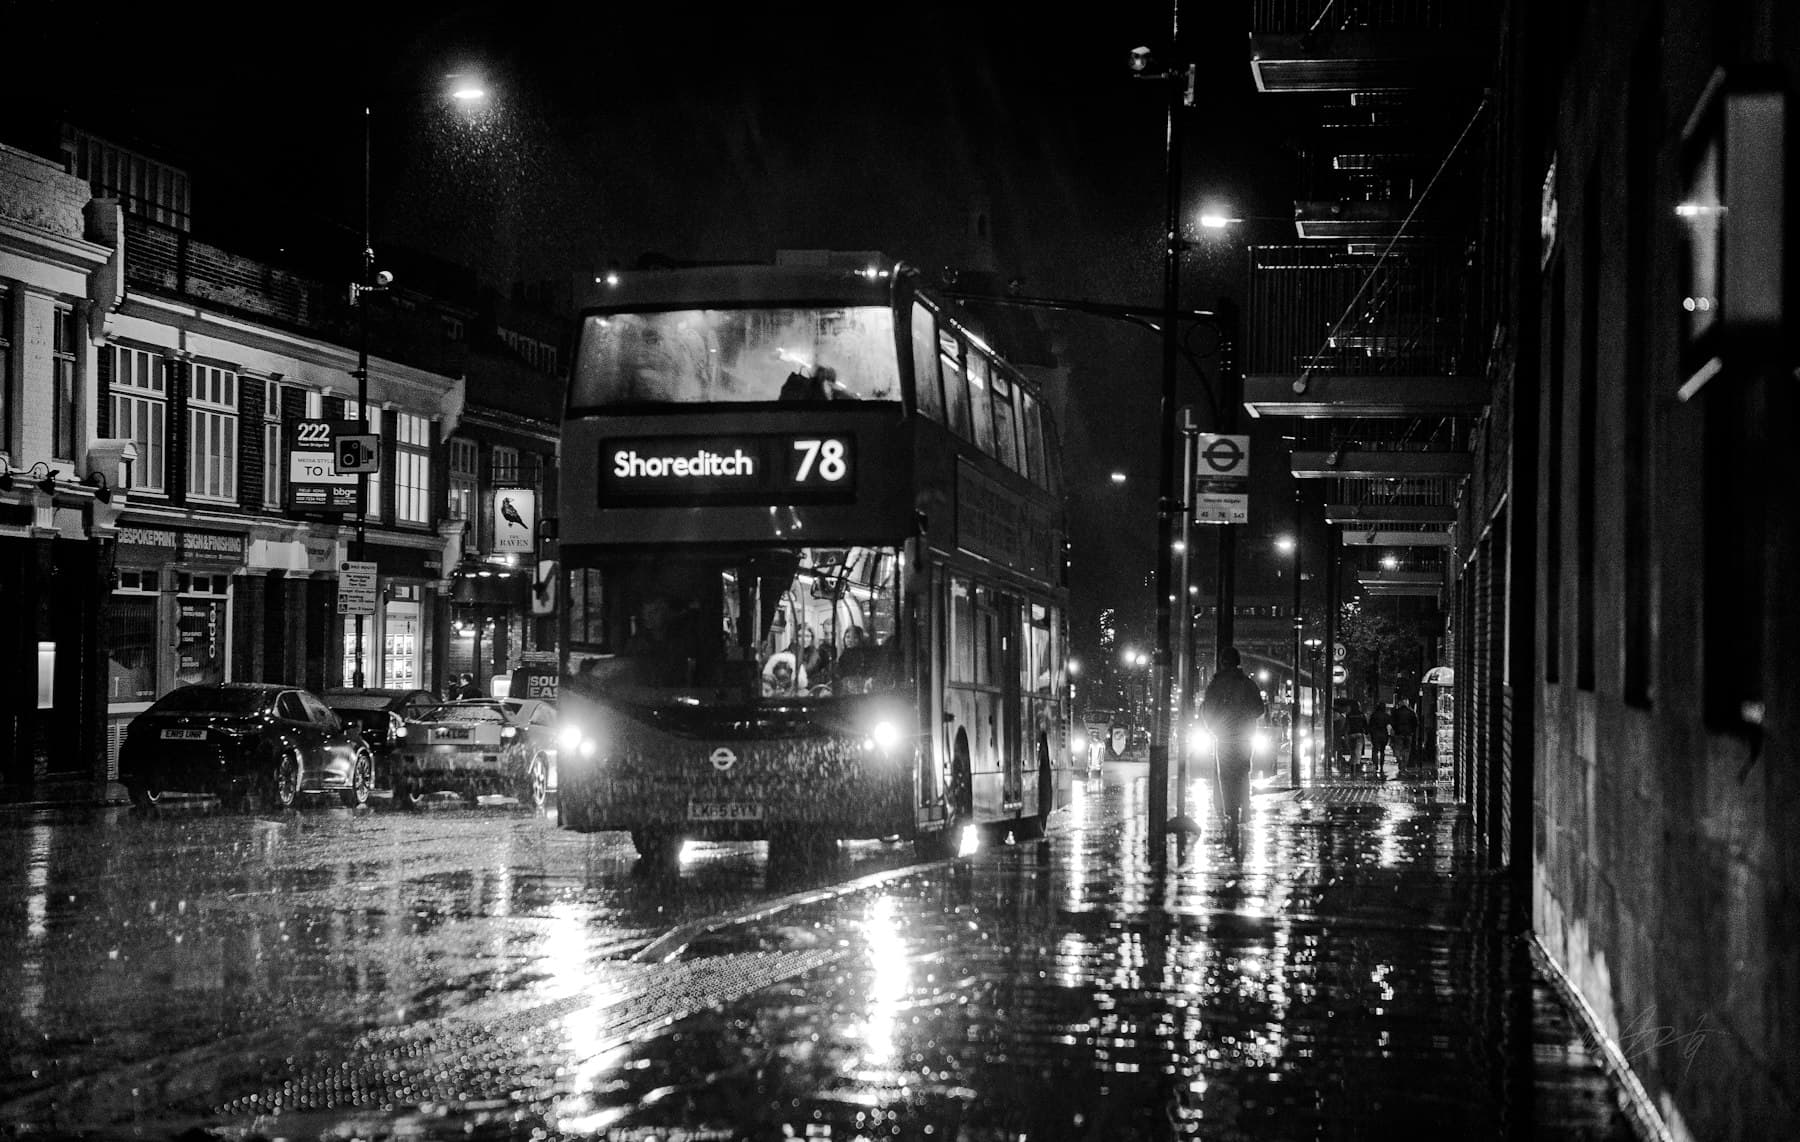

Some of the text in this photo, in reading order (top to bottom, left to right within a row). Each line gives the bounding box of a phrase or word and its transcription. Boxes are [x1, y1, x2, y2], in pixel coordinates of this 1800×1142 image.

[298, 423, 330, 442] 222
[614, 439, 846, 482] Shoreditch 78
[304, 466, 323, 477] TO
[333, 487, 350, 498] bbg
[208, 602, 217, 658] repro
[530, 675, 559, 687] SOU
